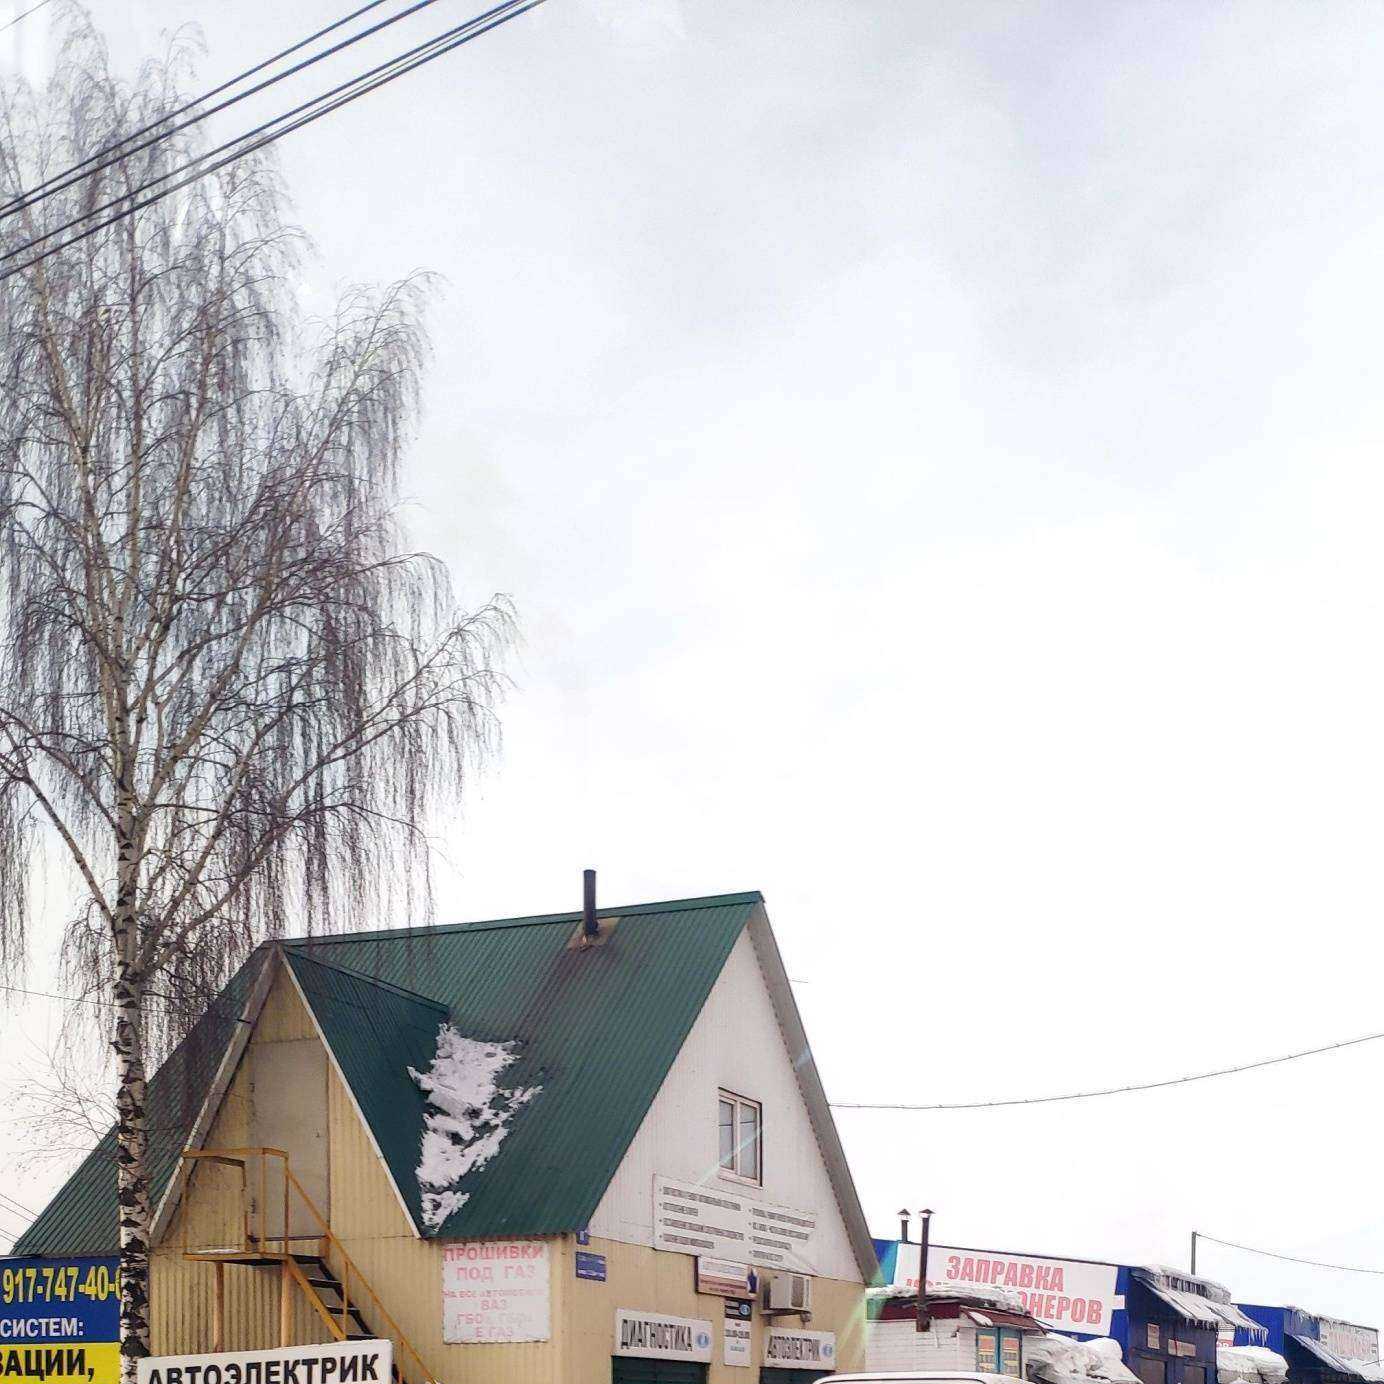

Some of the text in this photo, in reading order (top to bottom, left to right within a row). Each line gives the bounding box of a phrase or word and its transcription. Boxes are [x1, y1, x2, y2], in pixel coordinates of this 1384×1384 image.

[443, 1245, 543, 1261] ПРОШИВКИ
[457, 1265, 535, 1282] ПОД ГАЗ
[946, 1255, 1064, 1292] ЗАПРАВКА
[0, 1317, 84, 1338] СИСТЕМ:
[0, 1349, 94, 1382] АЦИИ,
